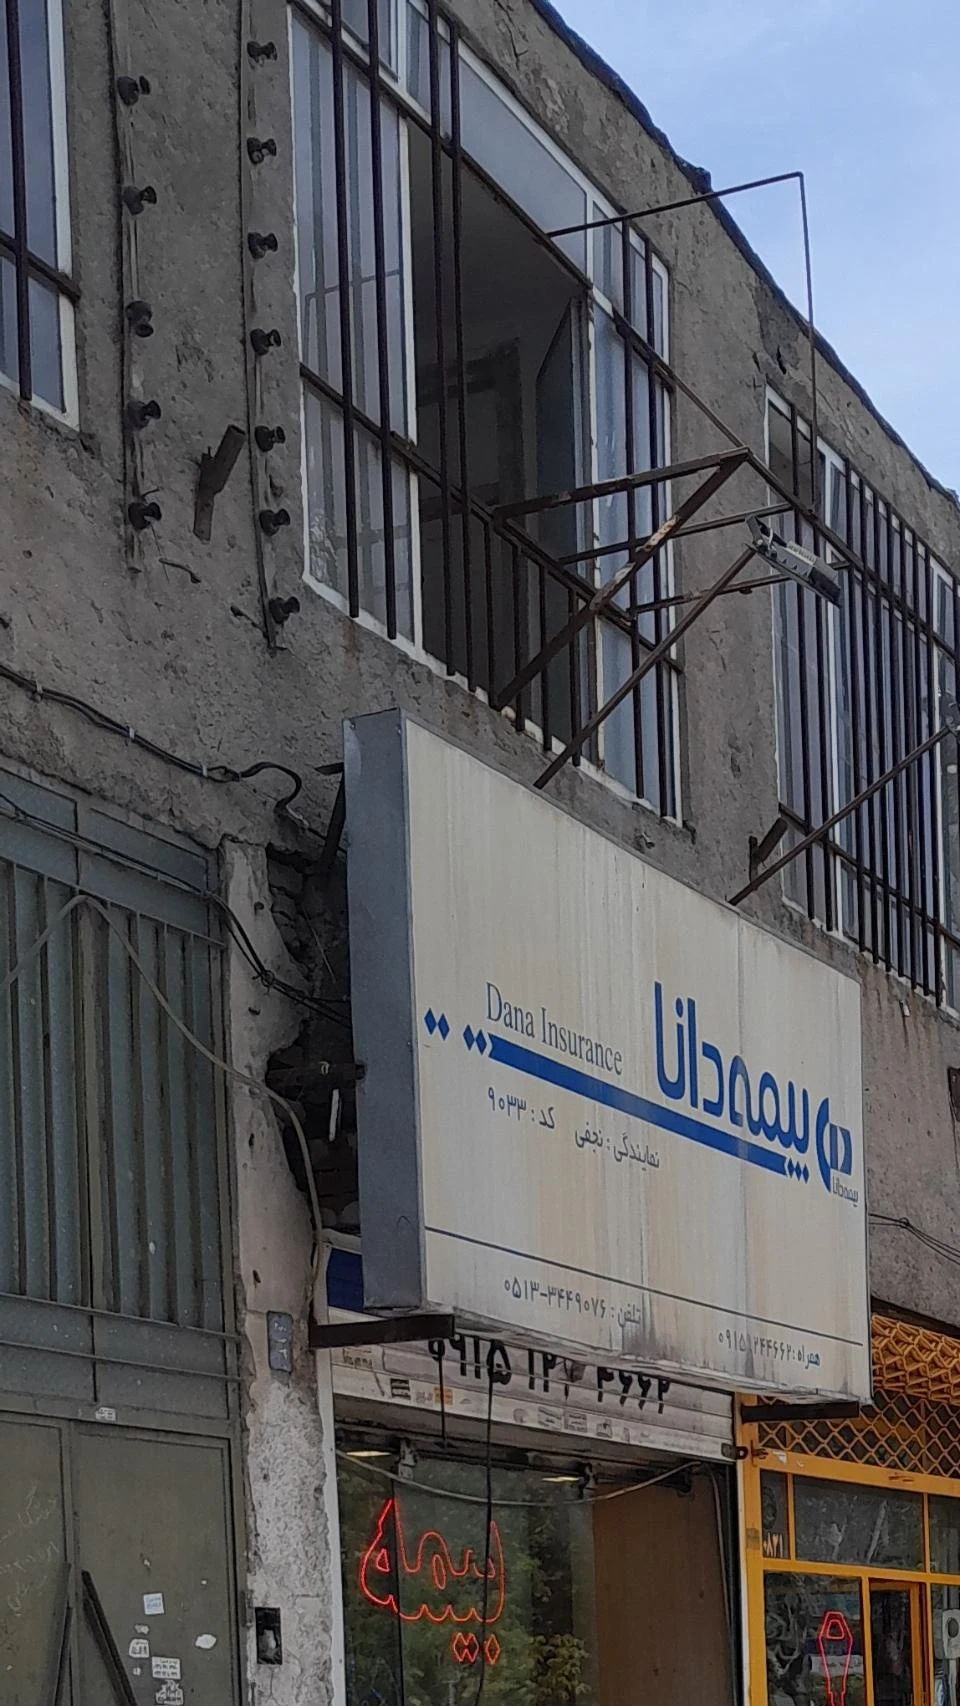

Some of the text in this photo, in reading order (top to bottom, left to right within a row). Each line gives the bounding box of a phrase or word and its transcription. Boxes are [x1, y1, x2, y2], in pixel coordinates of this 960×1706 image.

[486, 982, 623, 1076] Dana Insurance
[488, 1087, 527, 1120] ۹۰۳۳
[575, 1122, 604, 1154] نجفی
[360, 1498, 505, 1666] بیمه
